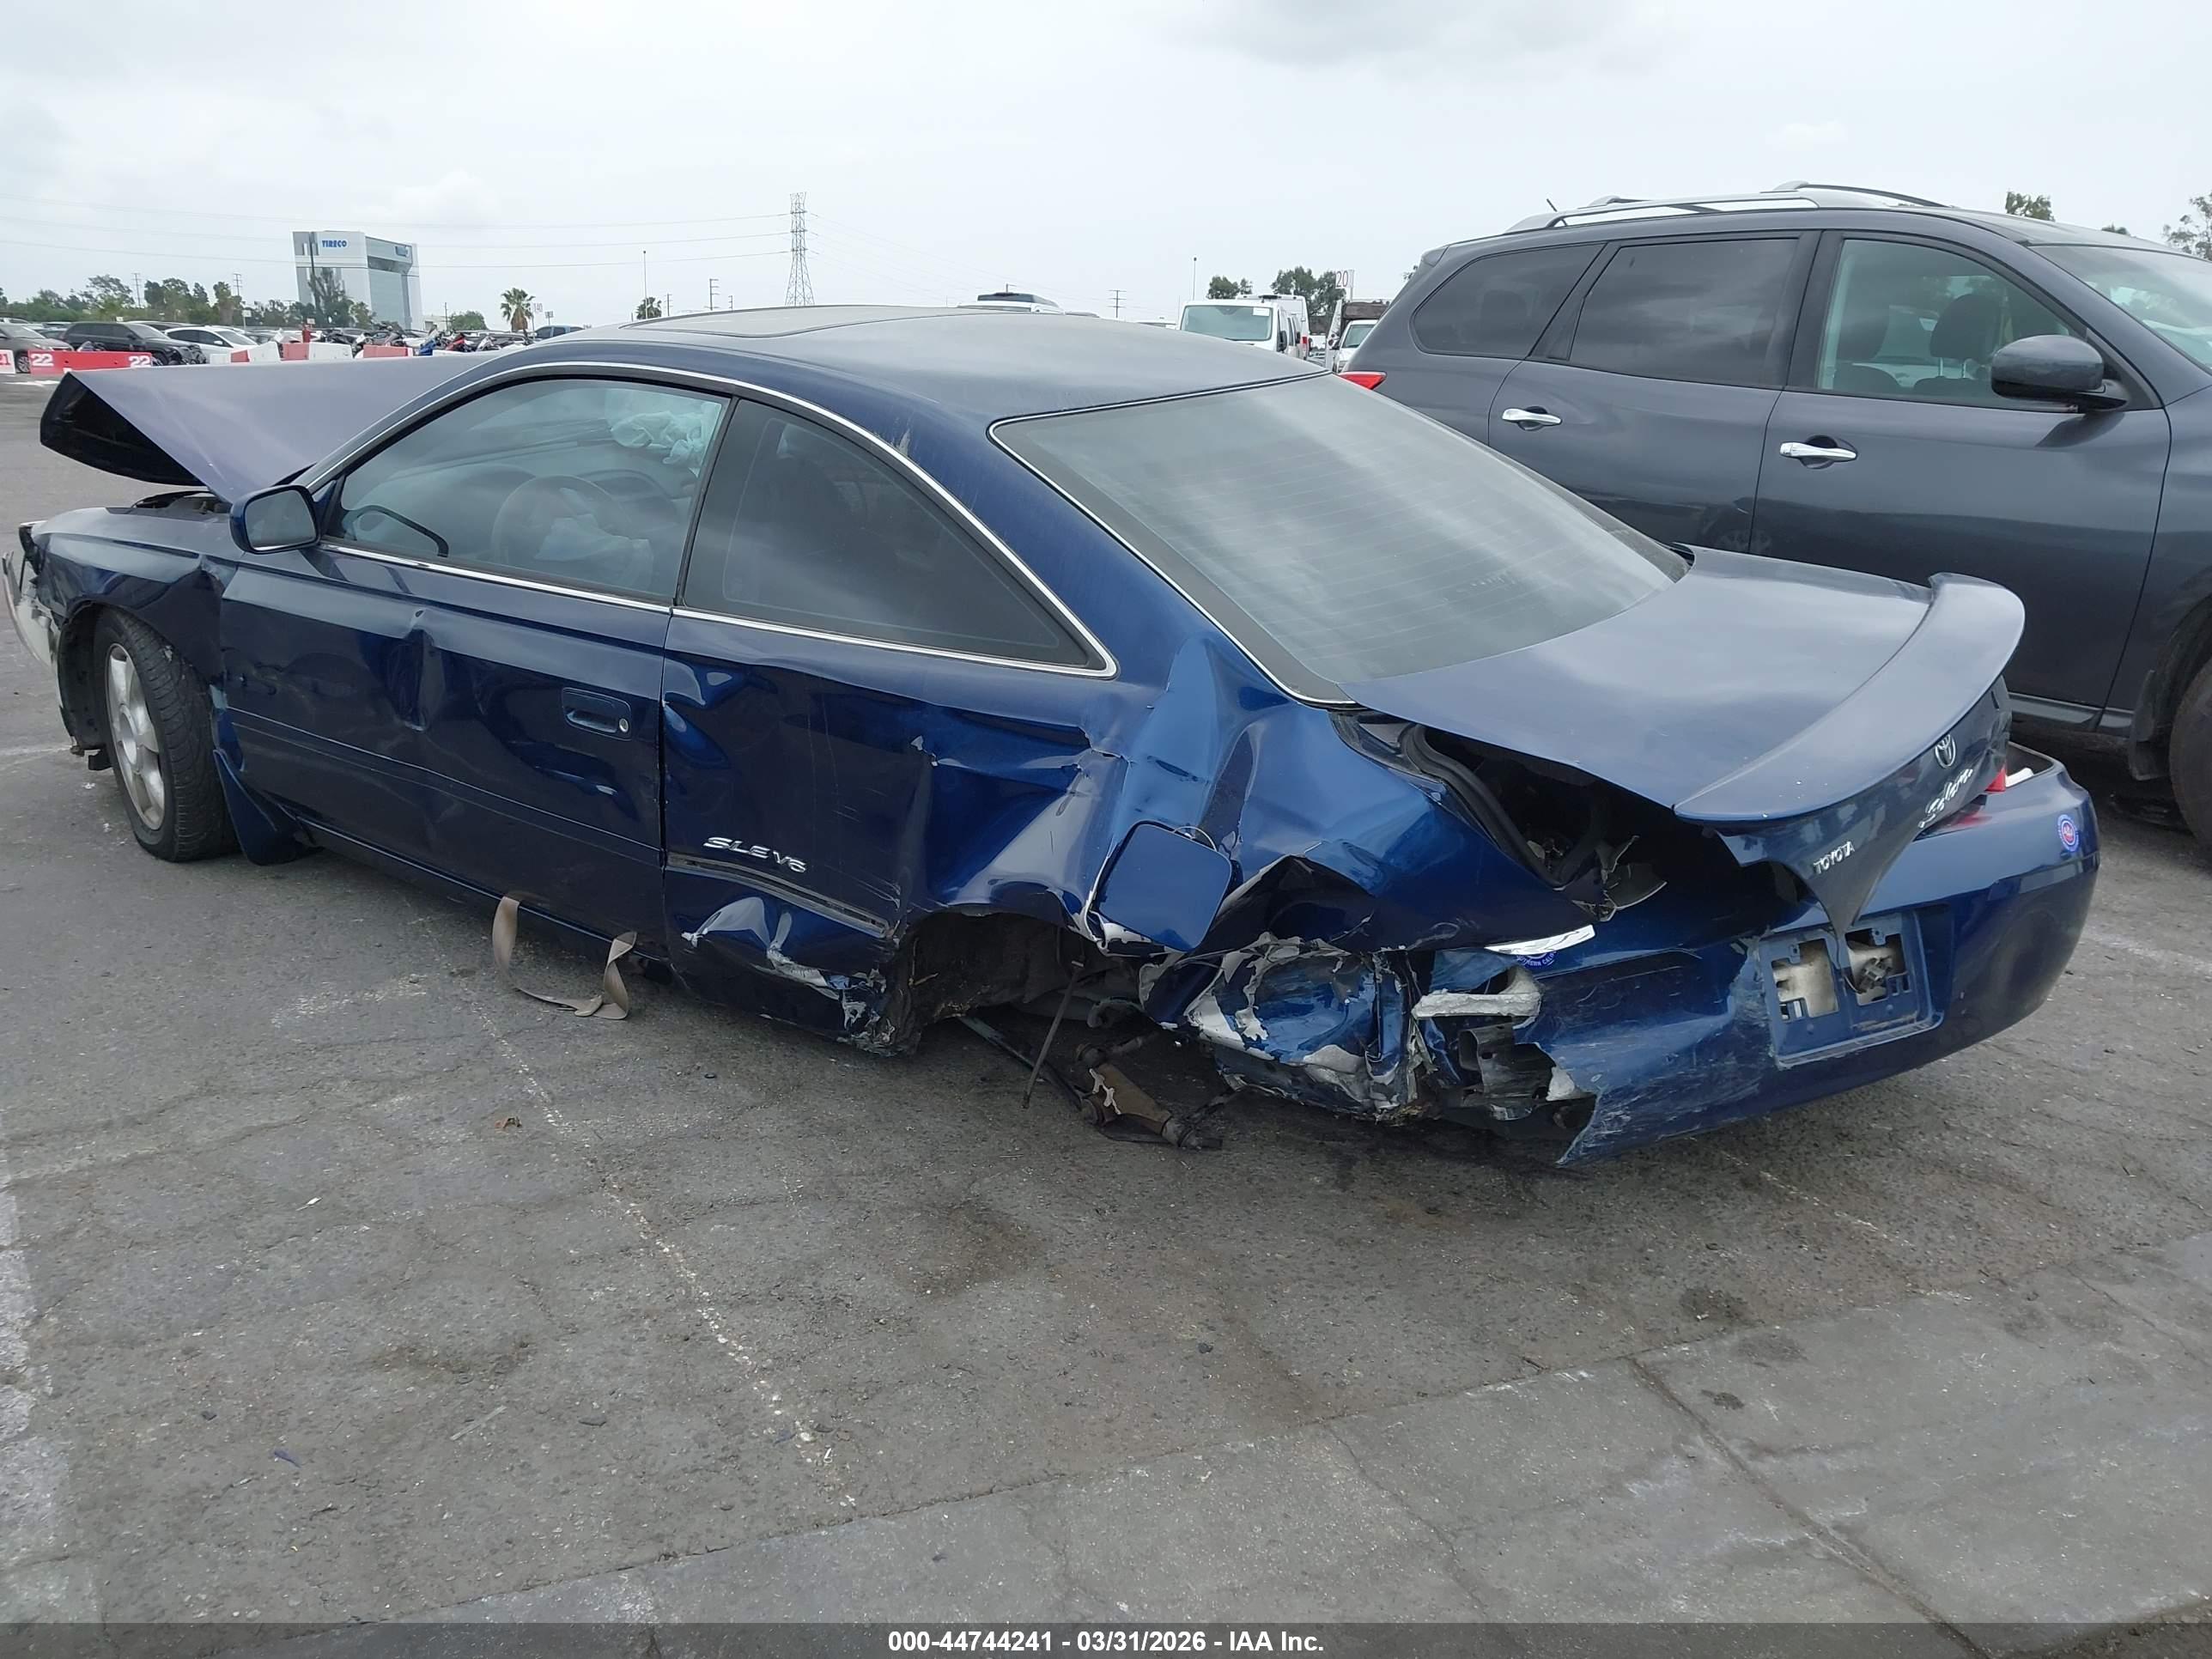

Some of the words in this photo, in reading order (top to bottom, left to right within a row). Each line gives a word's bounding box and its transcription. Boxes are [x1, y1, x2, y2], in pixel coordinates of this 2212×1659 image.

[321, 240, 348, 248] TIRECO
[30, 353, 54, 366] 22
[128, 355, 151, 368] 22
[1813, 841, 1856, 874] TOYOTA
